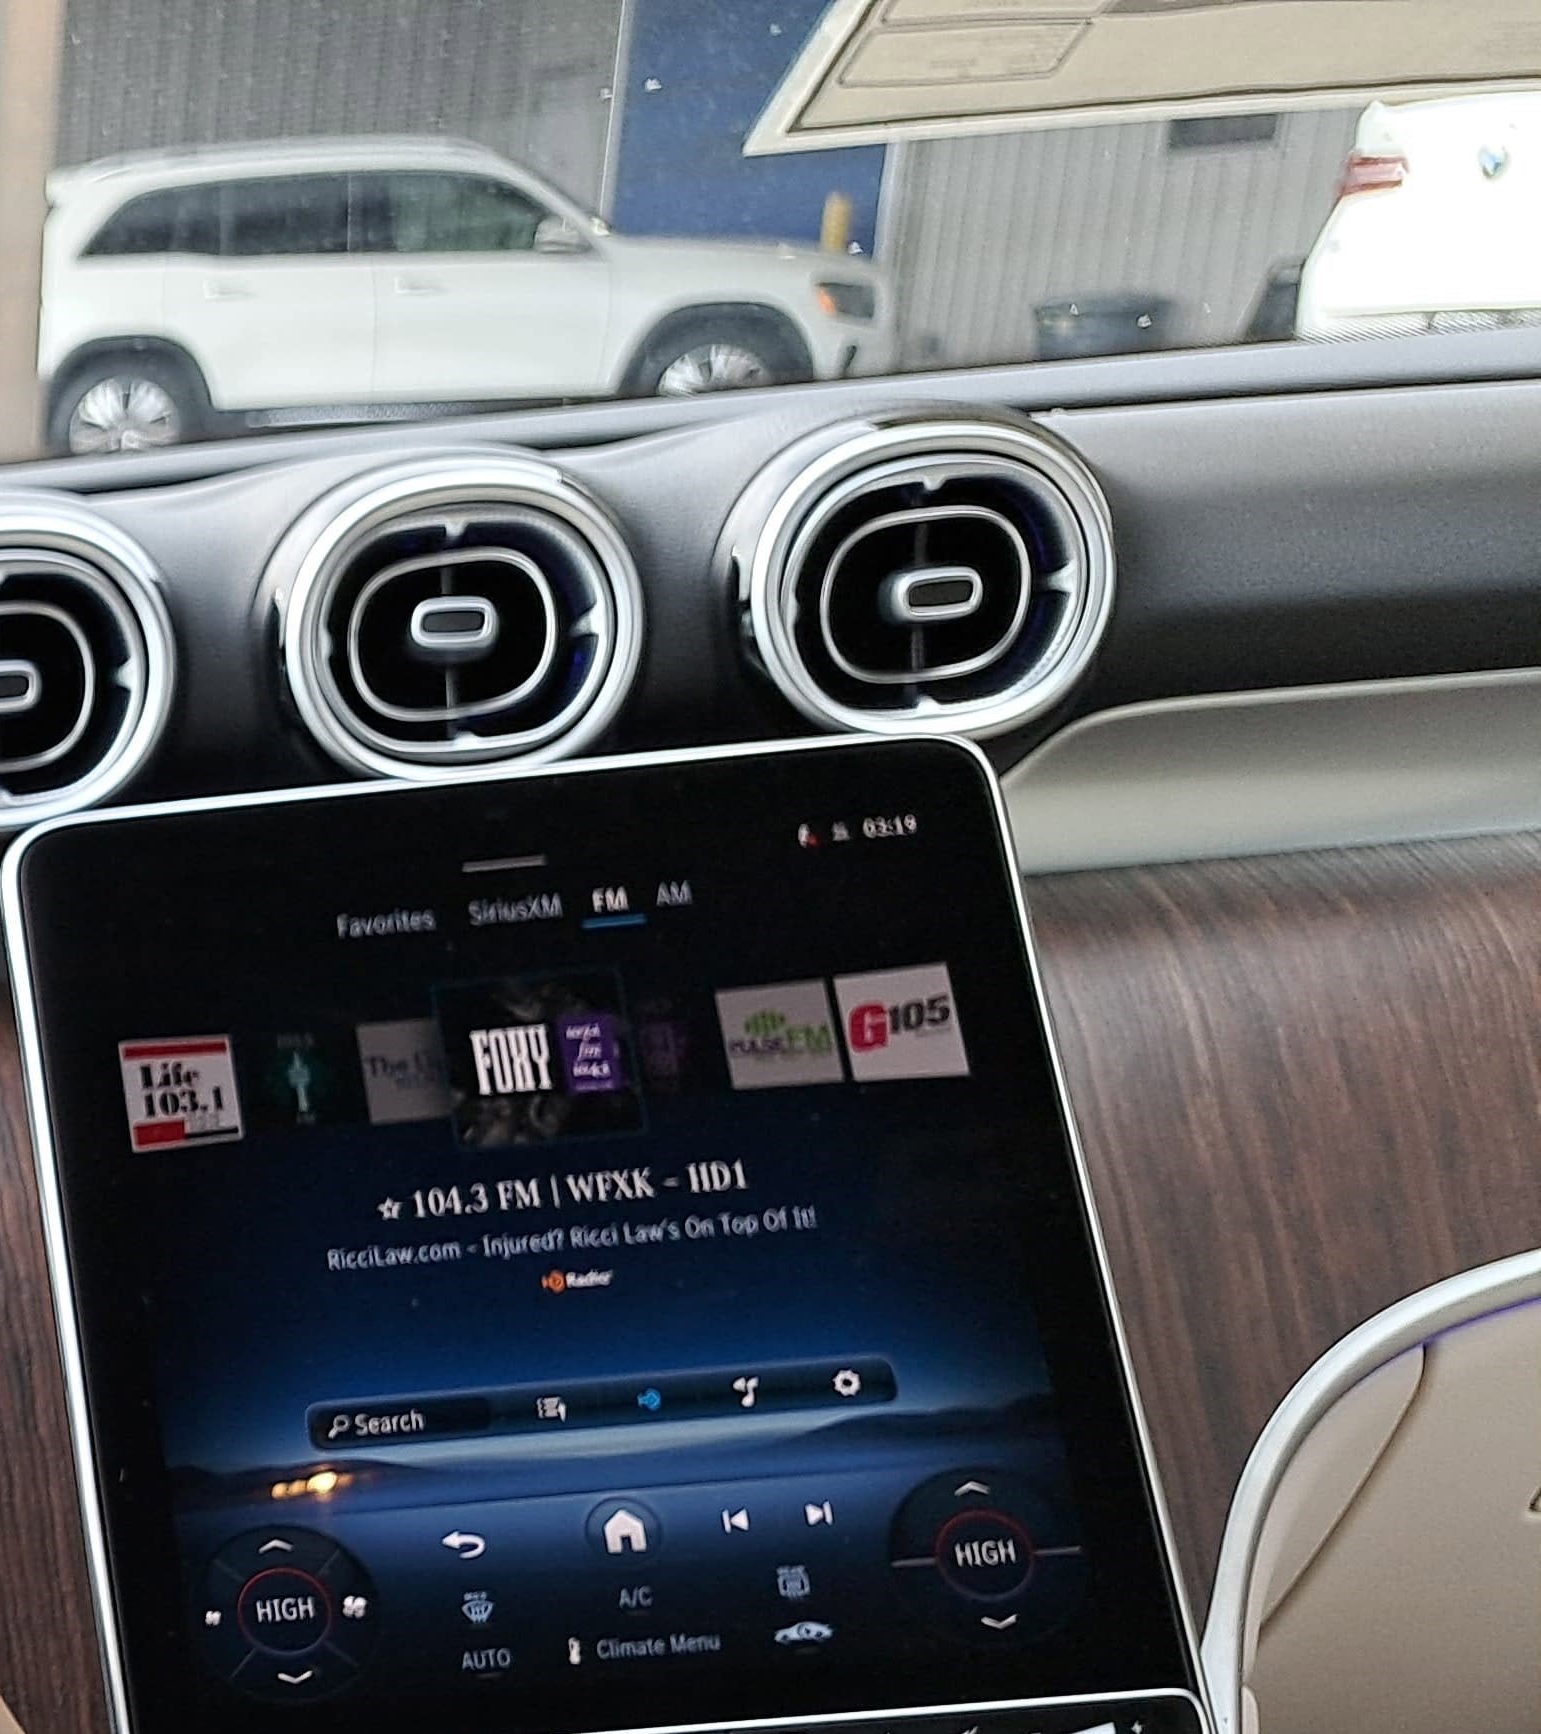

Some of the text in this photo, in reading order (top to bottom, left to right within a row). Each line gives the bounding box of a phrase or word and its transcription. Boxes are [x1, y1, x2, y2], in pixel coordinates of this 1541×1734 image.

[337, 880, 693, 939] Favorites SiriusXM FM AM
[848, 993, 951, 1053] G105
[140, 1061, 199, 1089] Life
[469, 1023, 552, 1096] FOXY
[144, 1085, 223, 1118] 103.1
[413, 1182, 489, 1218] 104.3
[496, 1177, 541, 1211] FM
[565, 1166, 655, 1203] WFXK
[327, 1241, 461, 1271] RicciLaw.com
[483, 1227, 564, 1260] Injured?
[570, 1222, 618, 1249] Ricci
[623, 1217, 680, 1245] Law's
[684, 1214, 715, 1239] On
[718, 1211, 759, 1238] Top
[763, 1205, 788, 1232] Of
[354, 1409, 424, 1436] Search
[953, 1535, 1017, 1569] HIGH
[255, 1596, 315, 1624] HIGH
[619, 1584, 653, 1609] A/C
[462, 1648, 511, 1671] AUTO
[597, 1632, 722, 1661] Climate Menu
